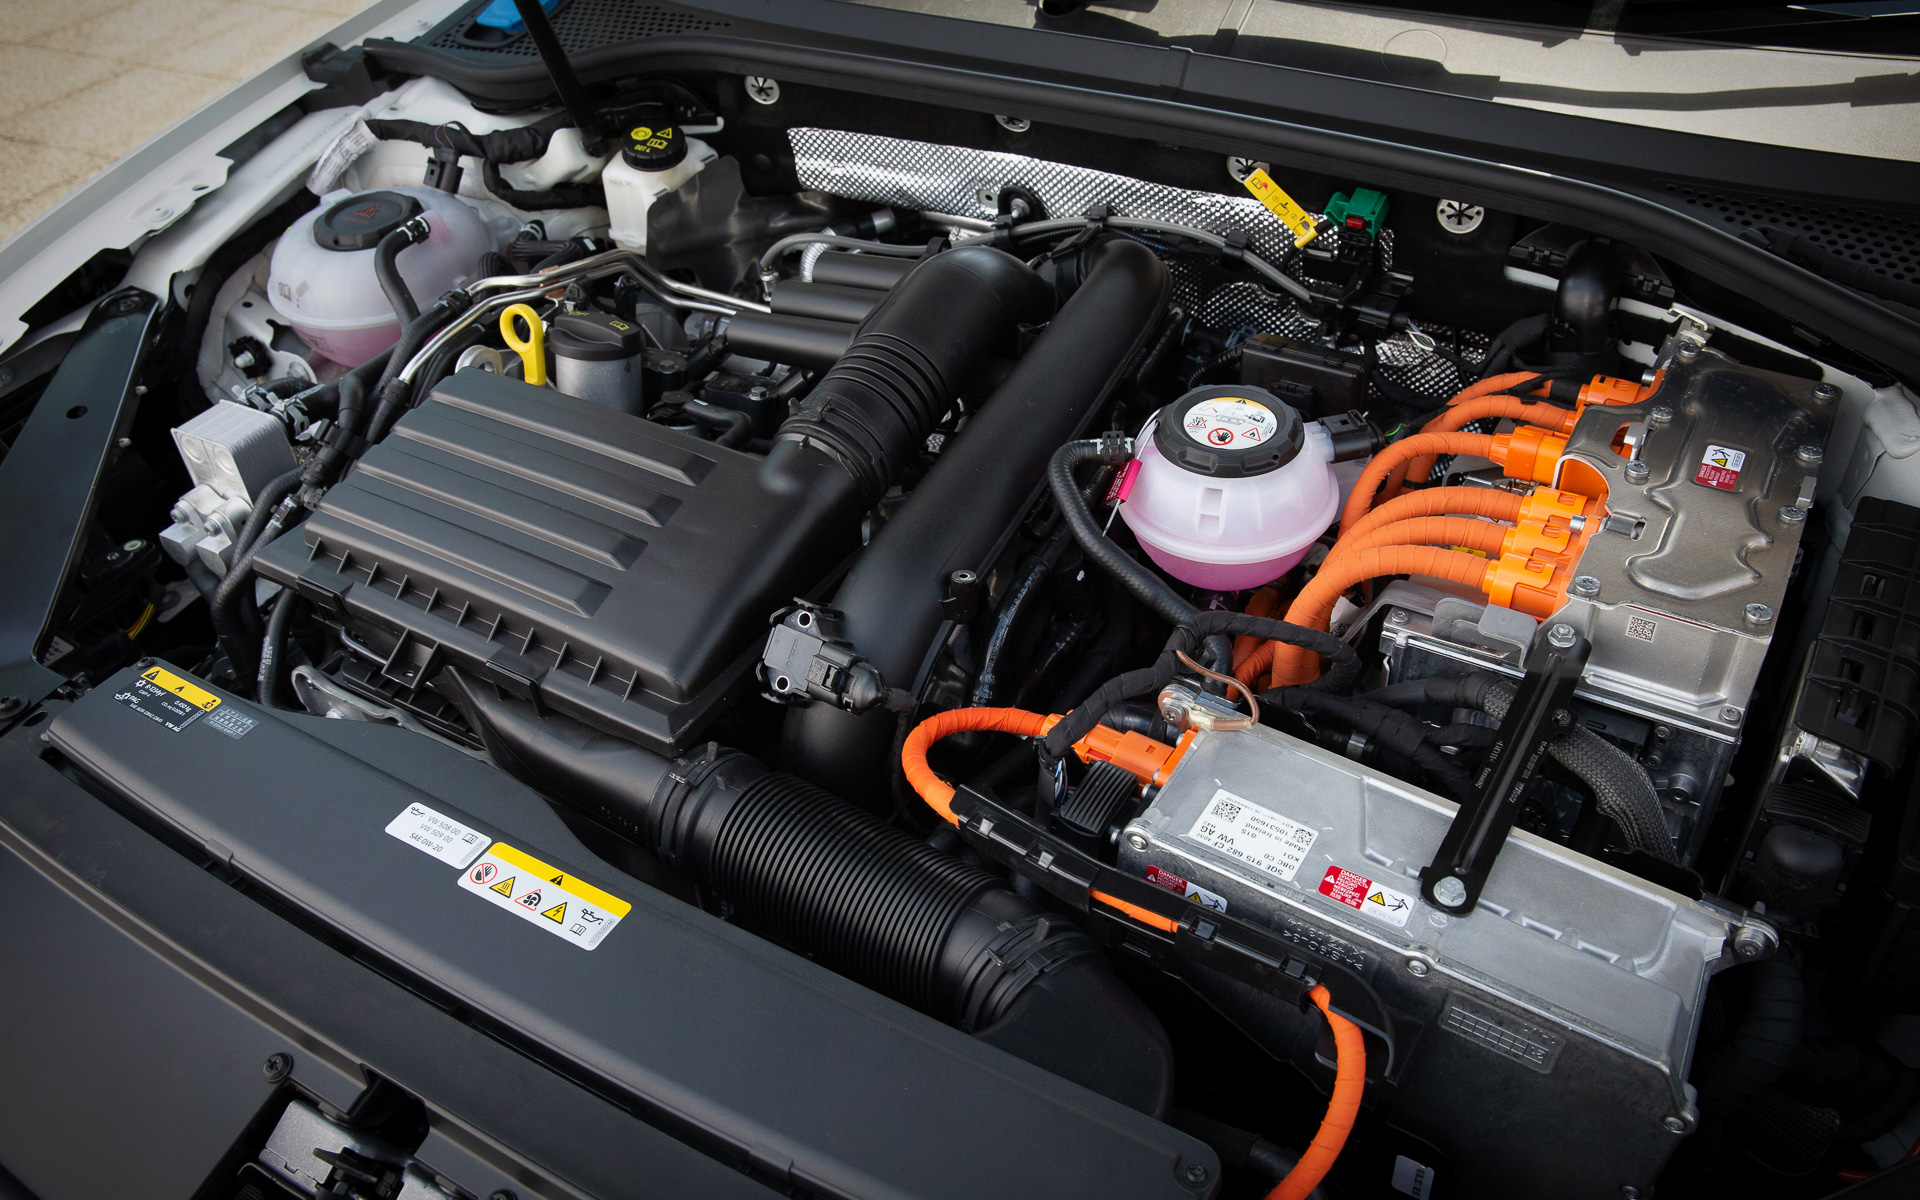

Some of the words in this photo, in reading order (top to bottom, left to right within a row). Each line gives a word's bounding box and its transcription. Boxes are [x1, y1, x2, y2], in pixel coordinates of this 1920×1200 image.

[428, 817, 439, 825] VW
[439, 822, 451, 831] 508
[1245, 822, 1272, 838] Ireland
[420, 824, 431, 832] VW
[431, 829, 443, 838] 509
[1200, 825, 1215, 836] AG
[410, 833, 422, 841] SAE
[421, 839, 443, 852] 0W-20
[1212, 840, 1224, 849] CF
[1218, 833, 1234, 845] VW
[1227, 846, 1243, 857] 682
[1284, 840, 1305, 853] Made
[1246, 855, 1262, 866] 915
[1159, 870, 1182, 882] DANGER
[1341, 870, 1367, 883] DANGER
[1336, 882, 1353, 890] PERIGO
[1337, 878, 1357, 888] PELIGRO
